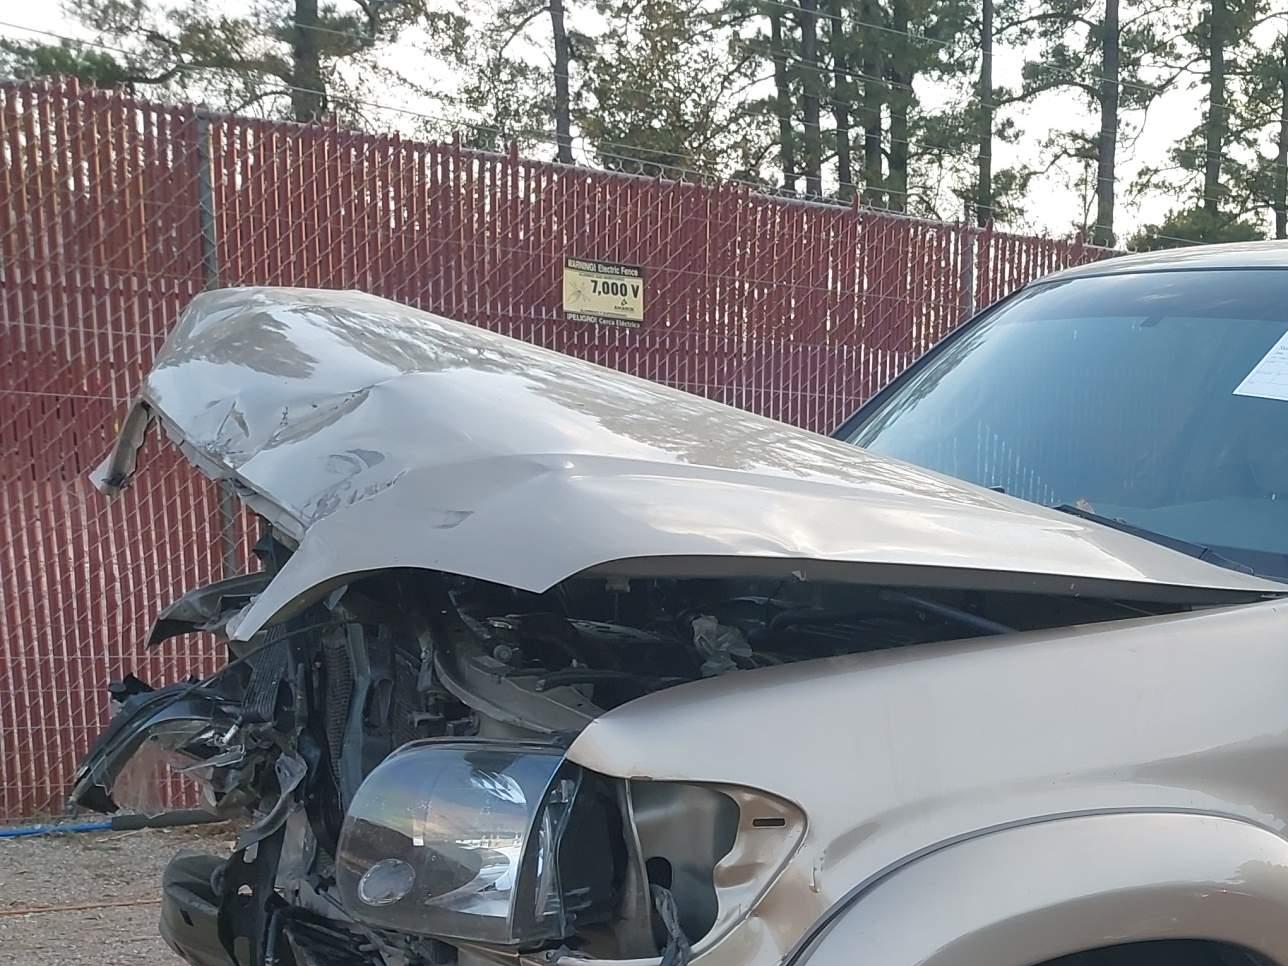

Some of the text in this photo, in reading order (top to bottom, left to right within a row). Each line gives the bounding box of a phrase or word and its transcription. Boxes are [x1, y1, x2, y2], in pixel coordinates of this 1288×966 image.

[621, 266, 639, 277] Fence
[590, 279, 640, 299] 7,000 V
